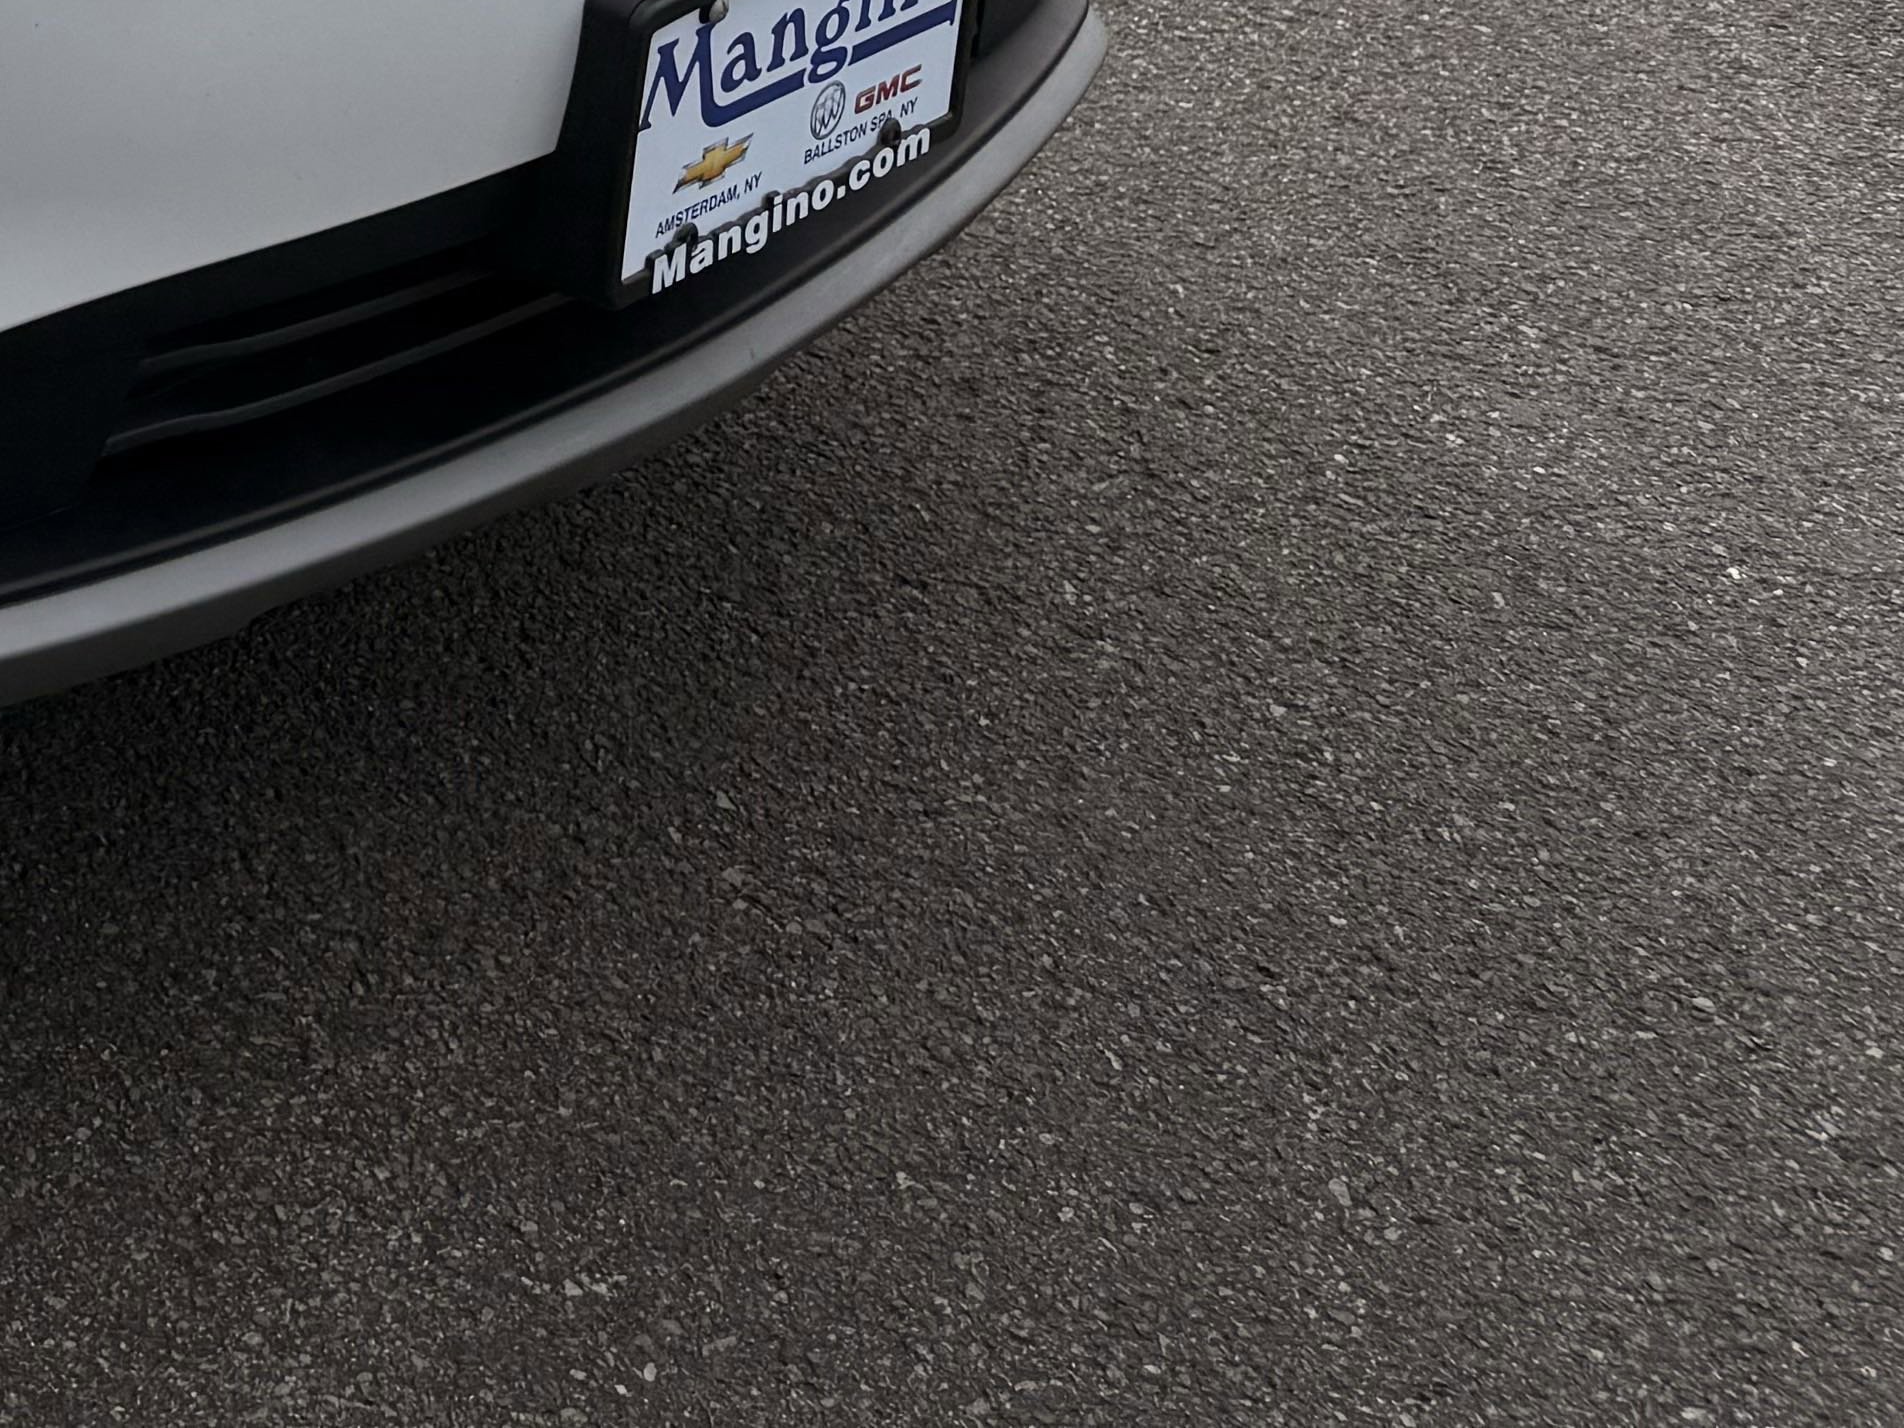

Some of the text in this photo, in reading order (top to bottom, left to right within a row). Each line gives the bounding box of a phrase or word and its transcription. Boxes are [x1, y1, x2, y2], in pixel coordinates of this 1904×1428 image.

[854, 64, 923, 115] GMC
[804, 121, 868, 165] BALLSTON
[899, 97, 918, 118] NY
[651, 127, 931, 295] Mangino.com
[655, 171, 763, 238] AMSTERDAM, NY
